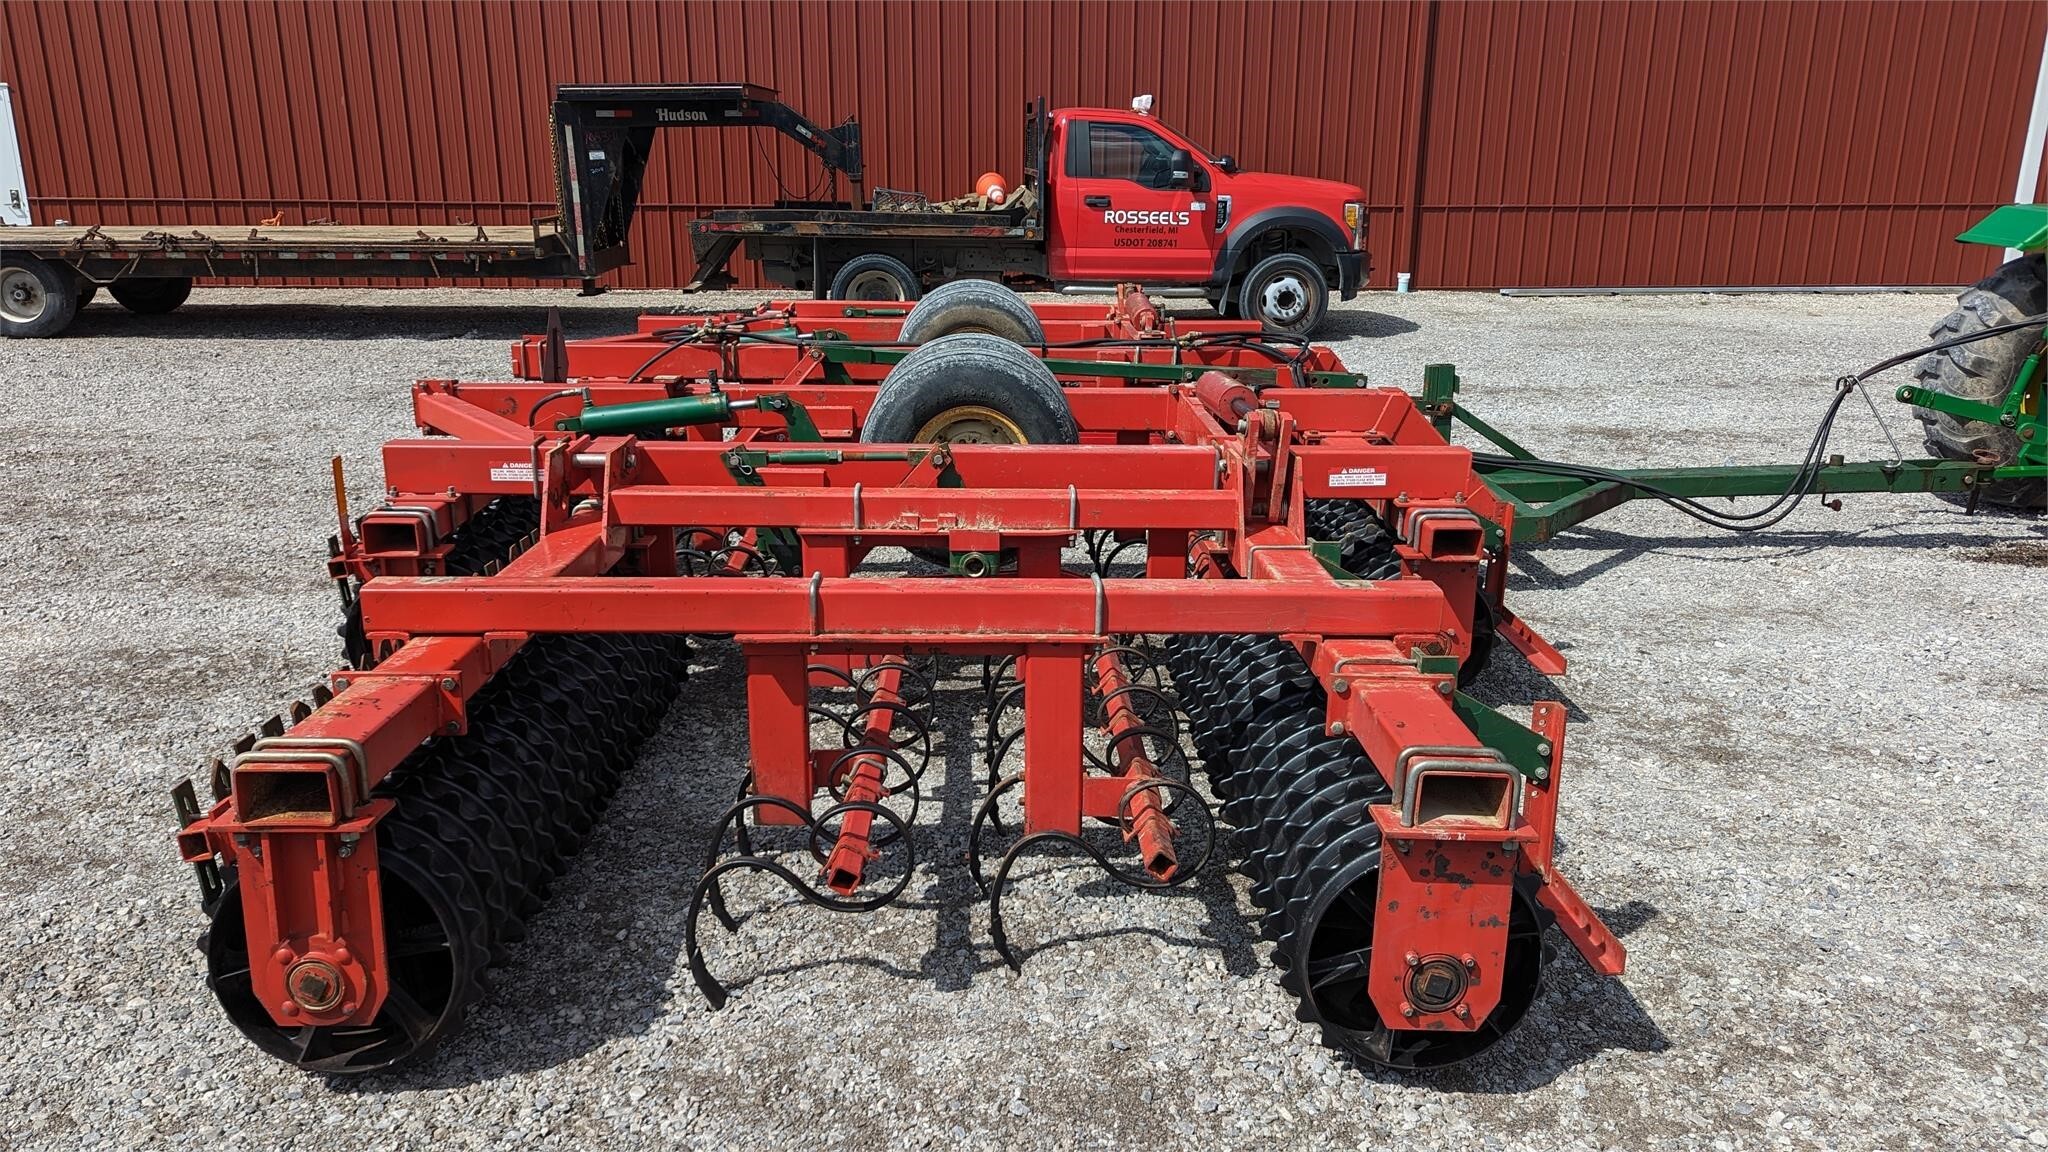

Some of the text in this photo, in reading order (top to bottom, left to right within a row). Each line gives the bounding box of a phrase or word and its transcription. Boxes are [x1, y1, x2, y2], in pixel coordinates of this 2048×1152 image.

[655, 108, 708, 121] Hudson
[1104, 210, 1190, 225] ROSSEEL'S
[1114, 225, 1178, 235] Chesterfield, MI
[1114, 238, 1178, 248] USDOT 208741
